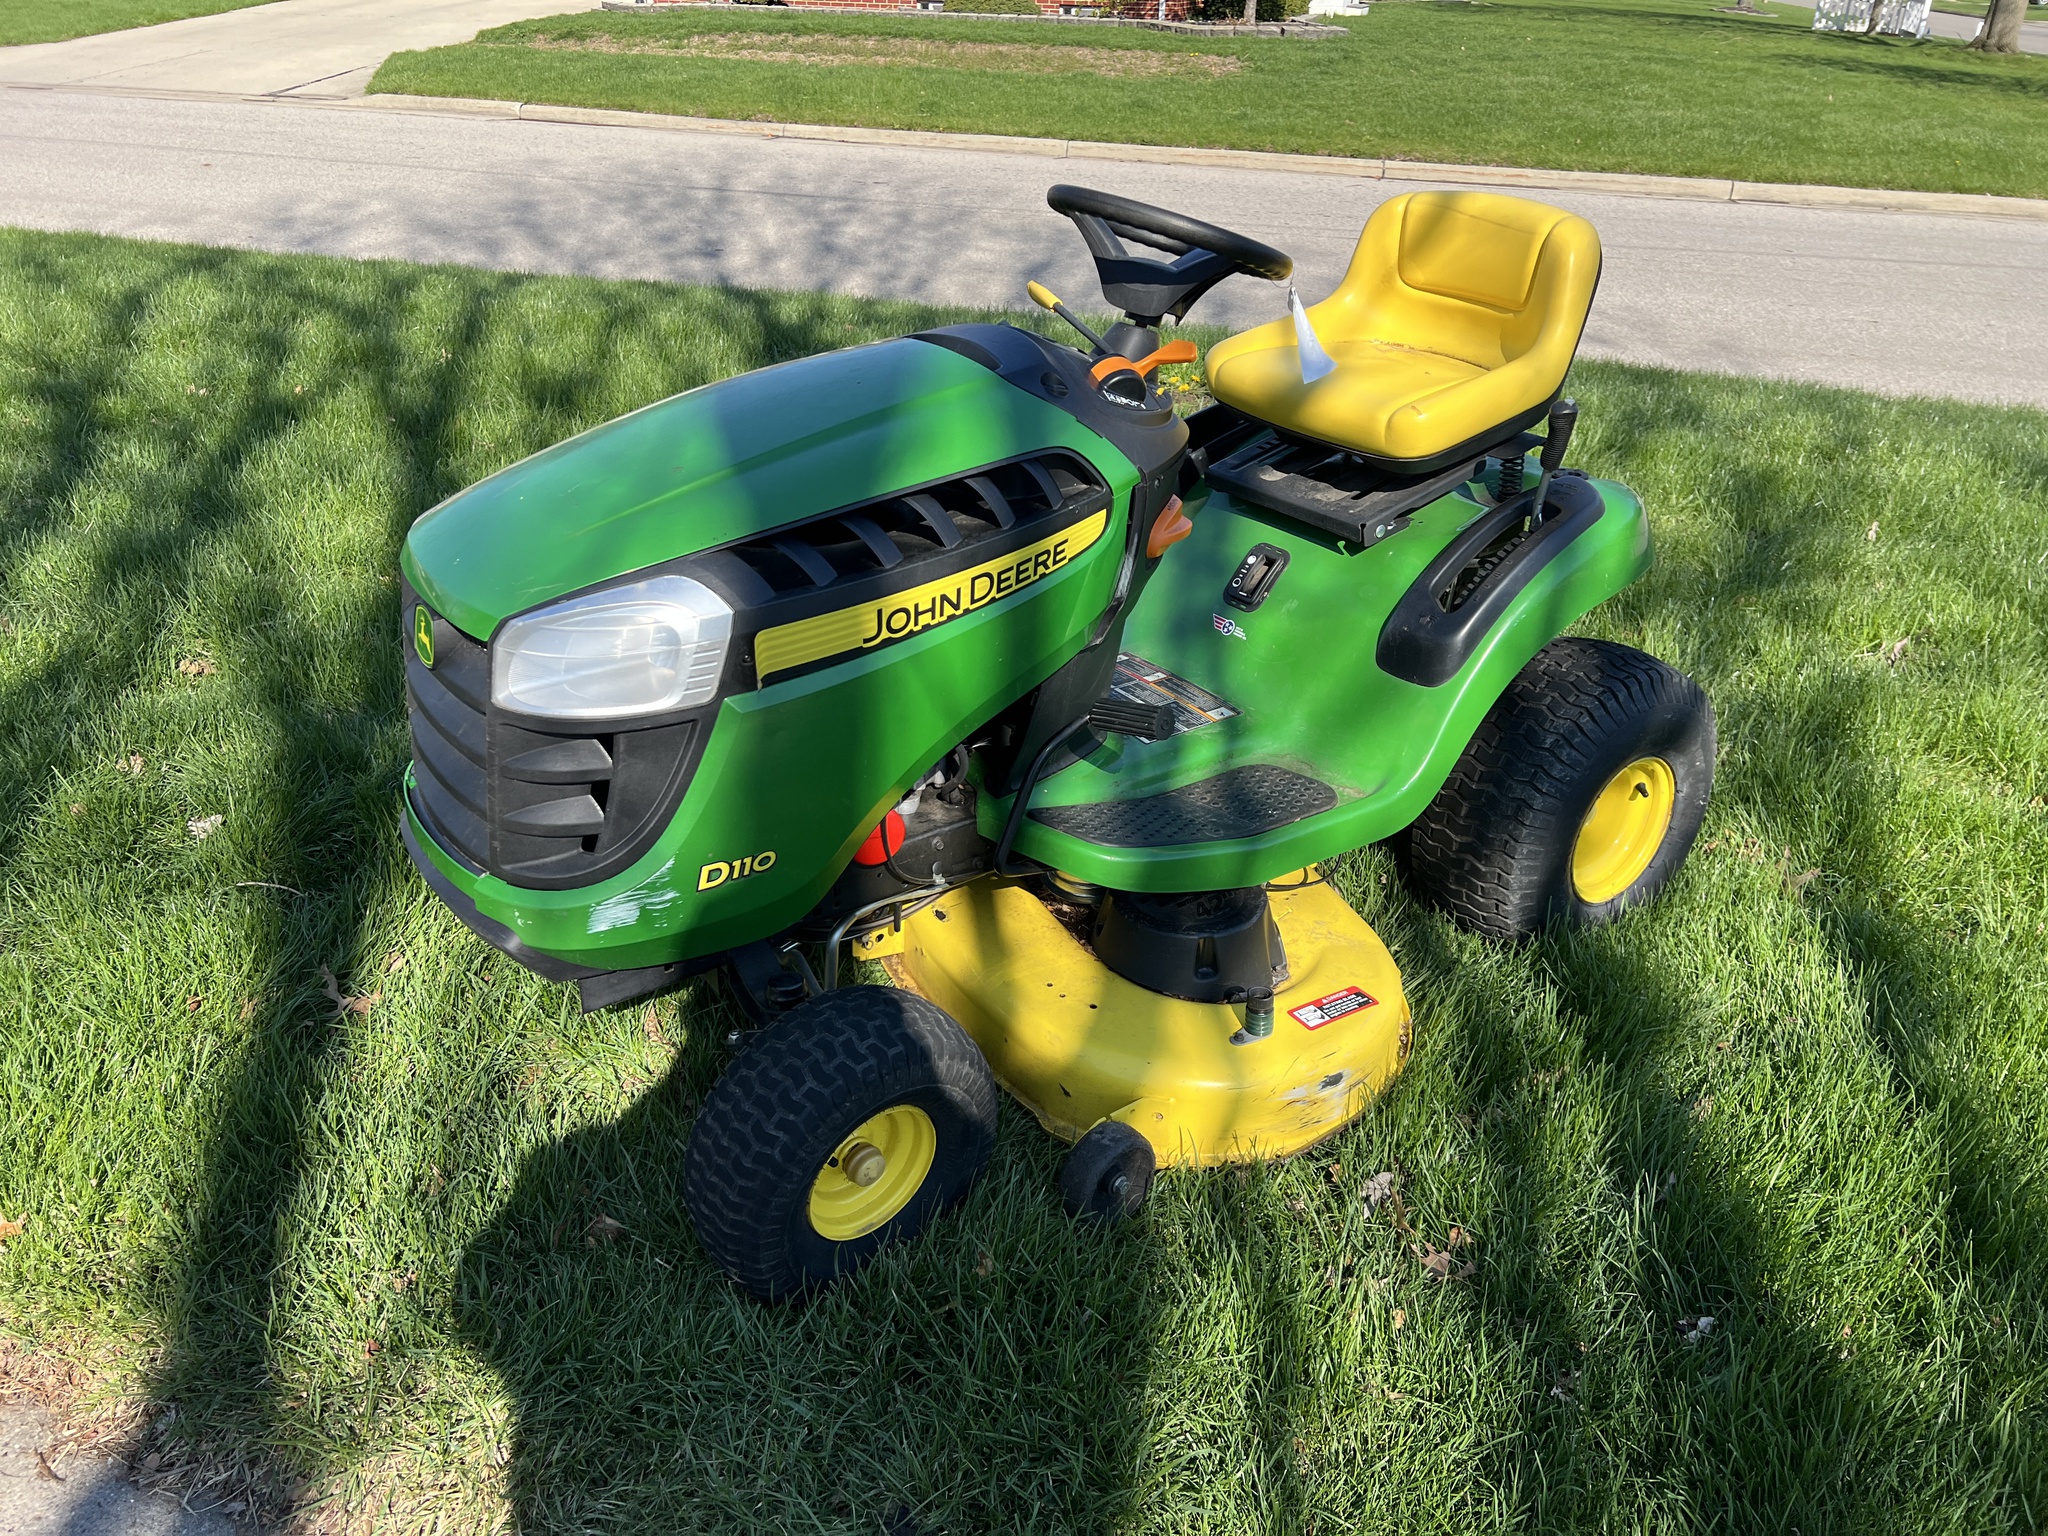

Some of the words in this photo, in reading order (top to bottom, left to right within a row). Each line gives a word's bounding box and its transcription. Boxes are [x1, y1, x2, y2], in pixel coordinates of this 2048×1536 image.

[863, 586, 962, 645] JOHN
[969, 537, 1070, 606] DEERE
[697, 850, 777, 892] D110
